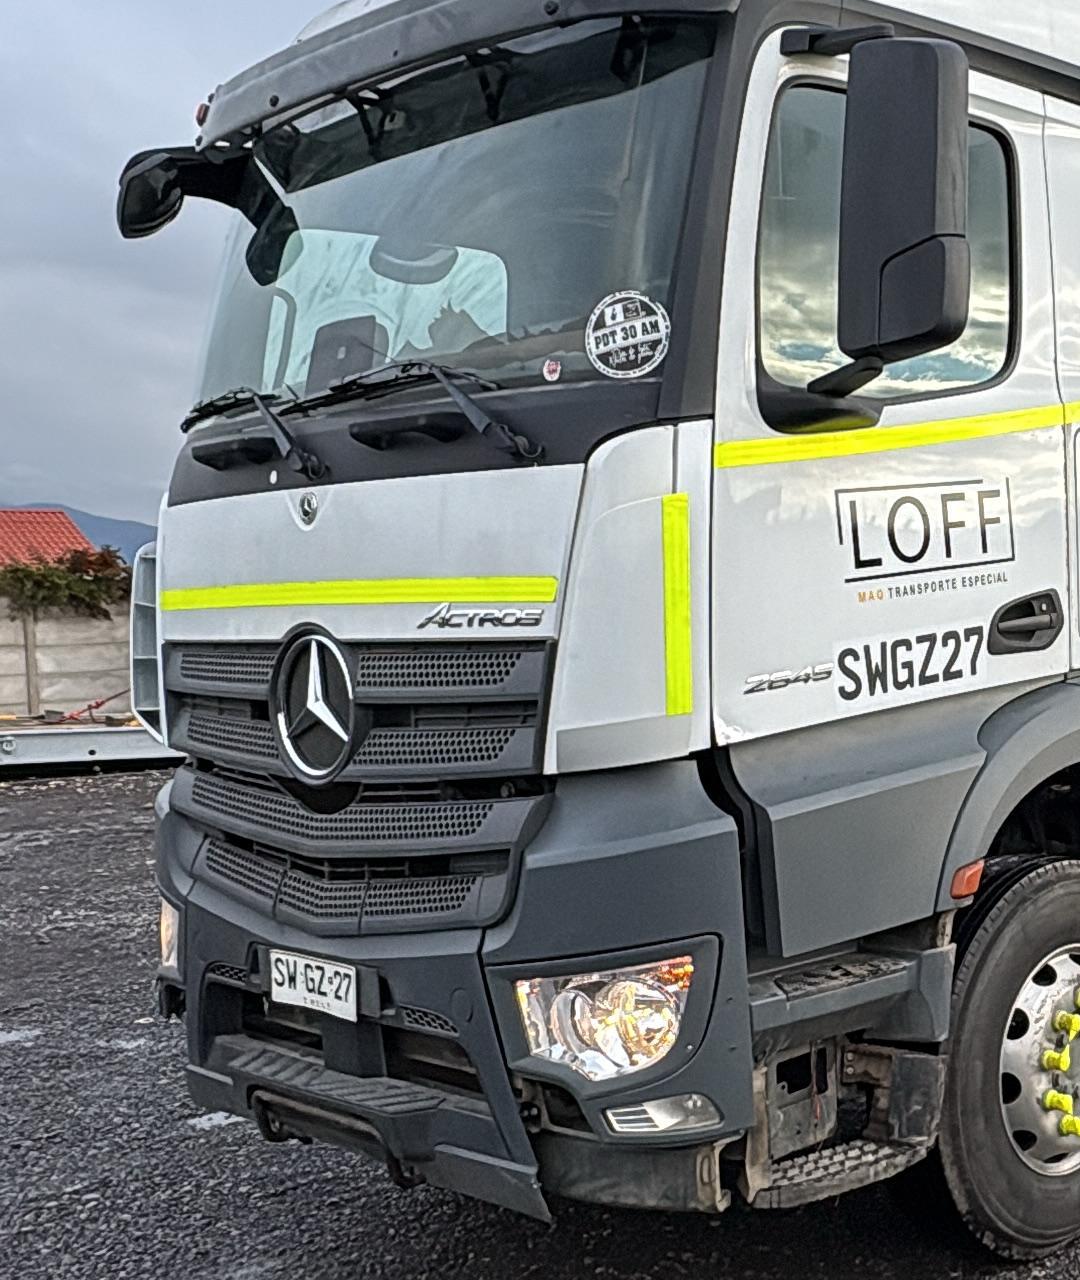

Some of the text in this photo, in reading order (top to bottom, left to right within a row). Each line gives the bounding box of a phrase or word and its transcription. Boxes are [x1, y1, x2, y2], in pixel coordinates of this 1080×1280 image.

[594, 319, 660, 350] PDT 30 AM
[849, 489, 1001, 569] LOFF
[887, 577, 957, 599] TRANSPORTE
[961, 571, 1008, 588] ESPECIAL
[416, 602, 544, 629] ACTROS
[743, 625, 984, 701] 2645 SWGZ27
